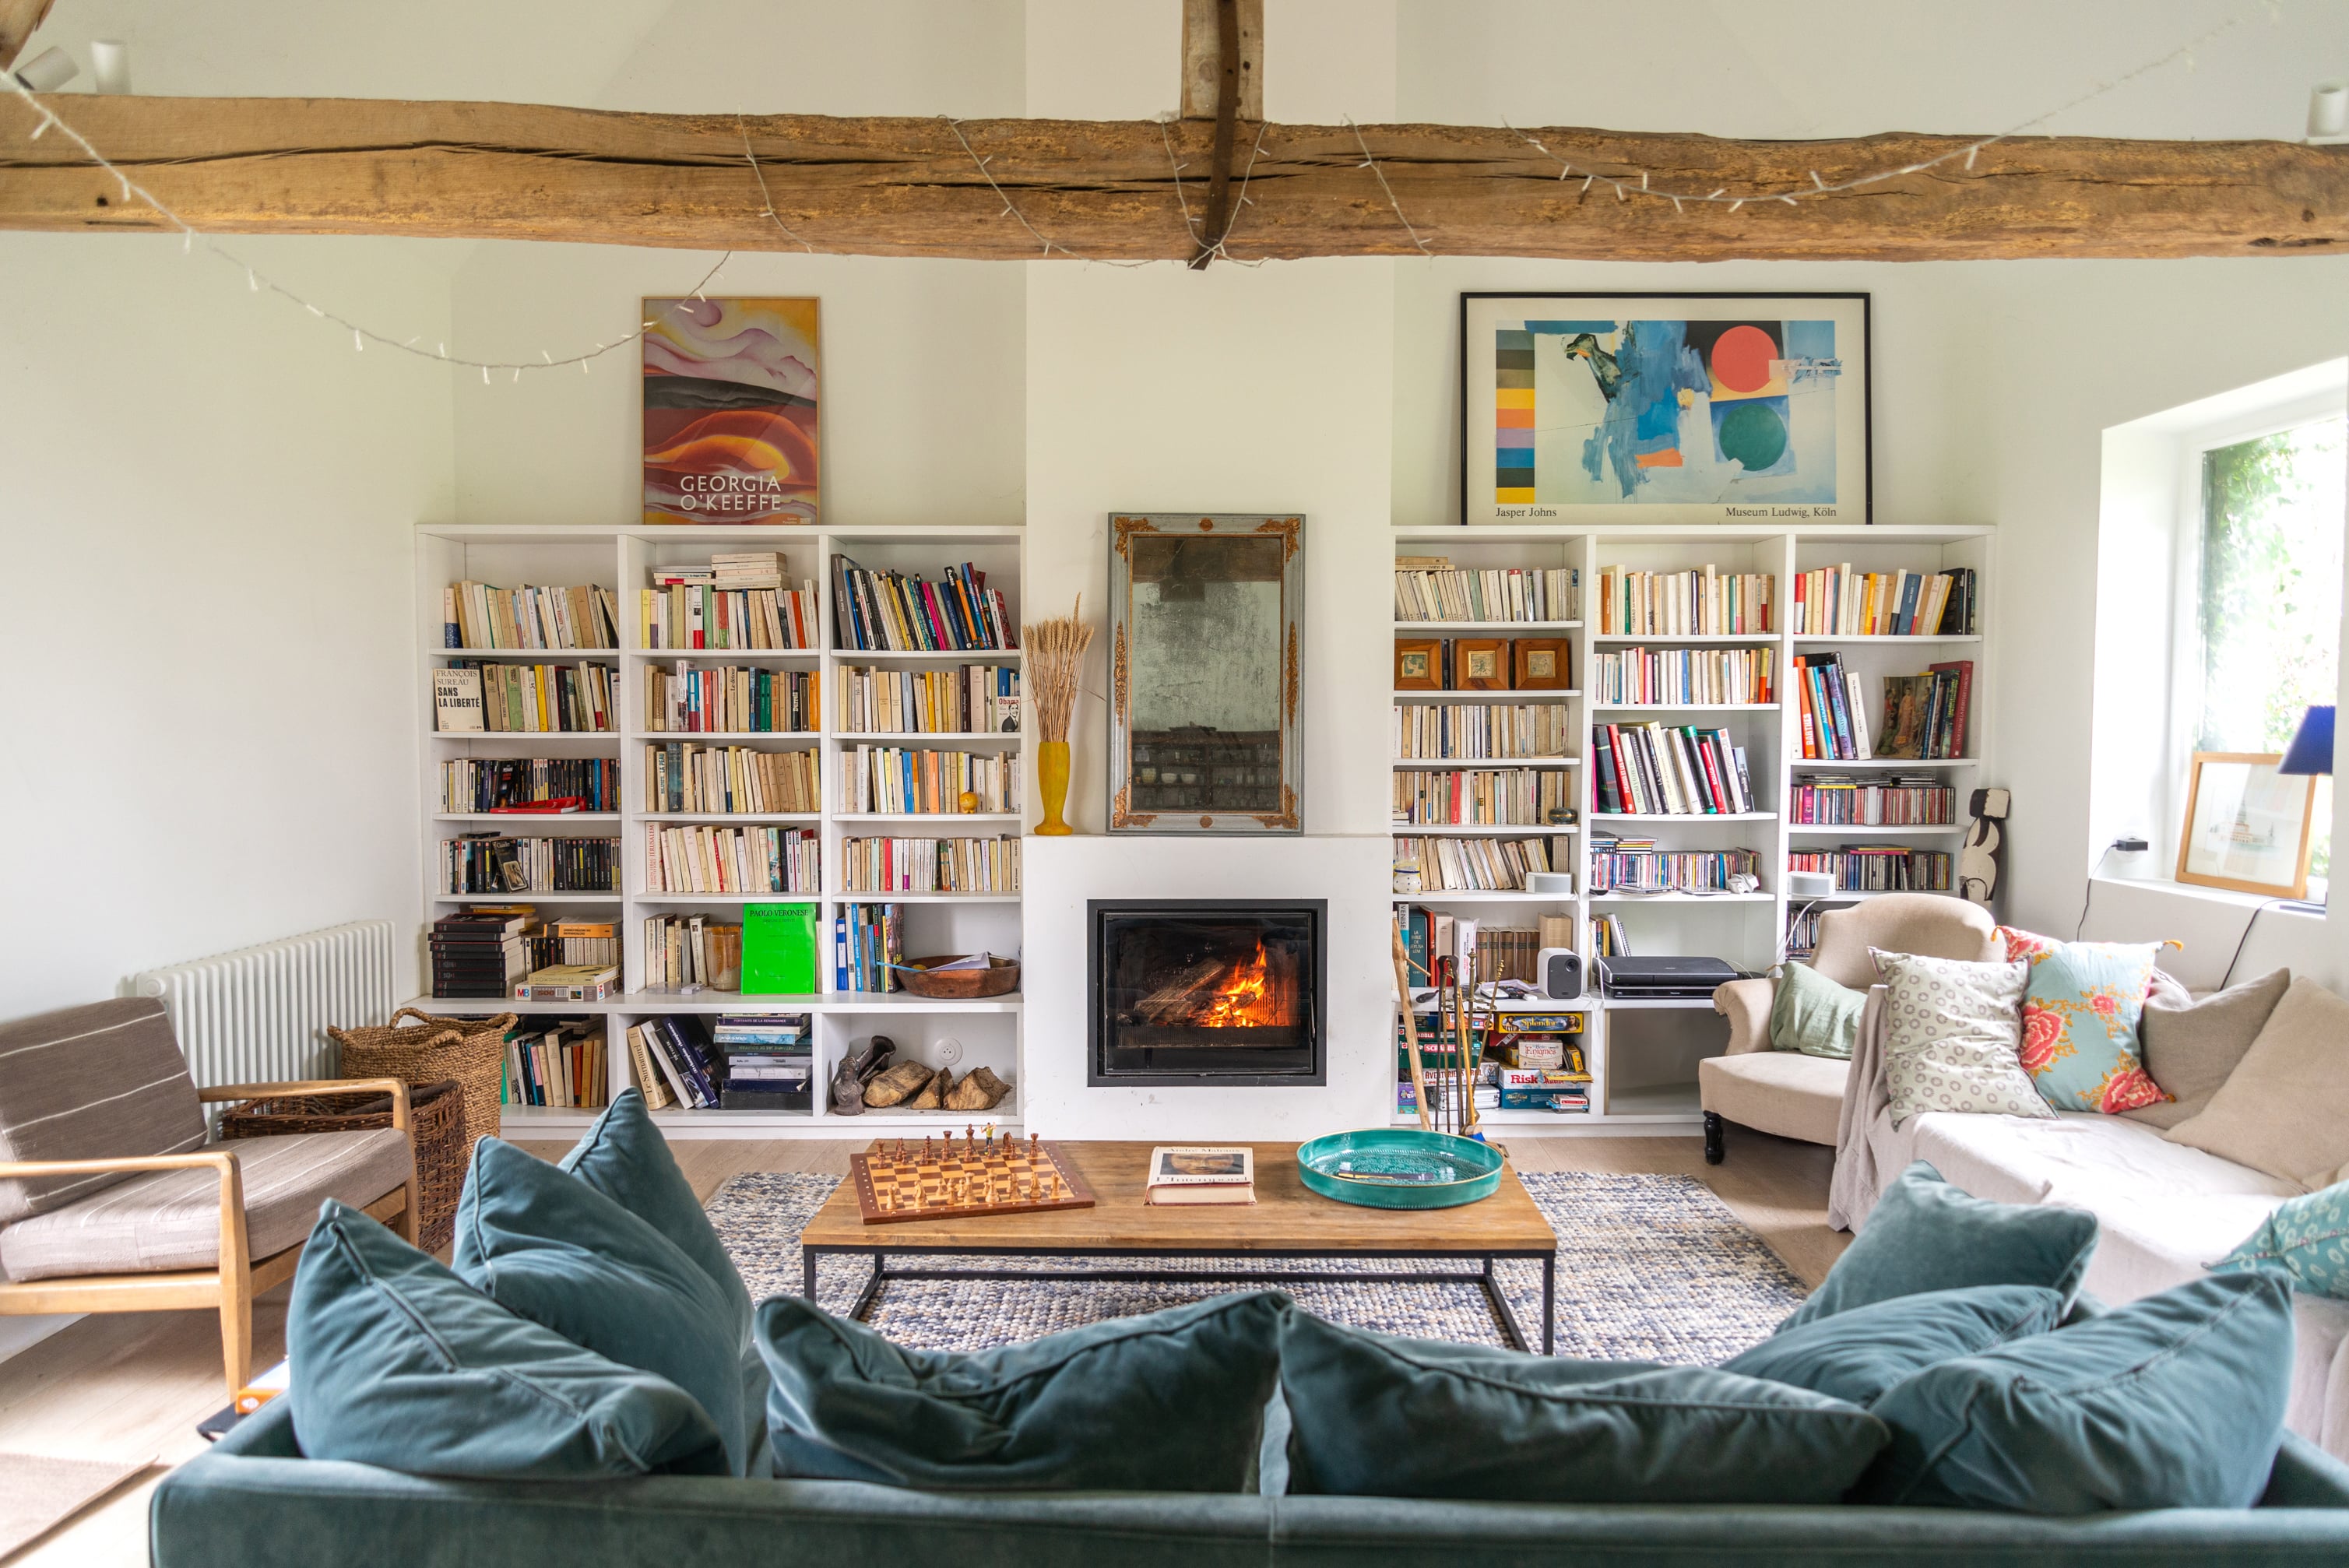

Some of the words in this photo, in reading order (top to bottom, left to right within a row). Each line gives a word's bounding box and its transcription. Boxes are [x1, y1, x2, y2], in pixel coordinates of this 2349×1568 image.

[680, 476, 781, 492] GEORGIA
[680, 494, 781, 511] O'KEEFFE
[1496, 508, 1526, 519] Jasper
[1528, 508, 1556, 517] Johns
[1725, 508, 1768, 517] Museum
[1771, 507, 1809, 519] Ludwig,
[1813, 507, 1837, 517] Köln
[436, 670, 477, 679] FRANÇOIS
[438, 687, 458, 697] SANS
[438, 698, 448, 707] LA
[450, 697, 480, 707] LIBERTÉ
[1802, 713, 1813, 745] BARTHES
[517, 988, 529, 997] MB
[1521, 1018, 1557, 1029] Splendor
[1511, 1074, 1538, 1084] Risk
